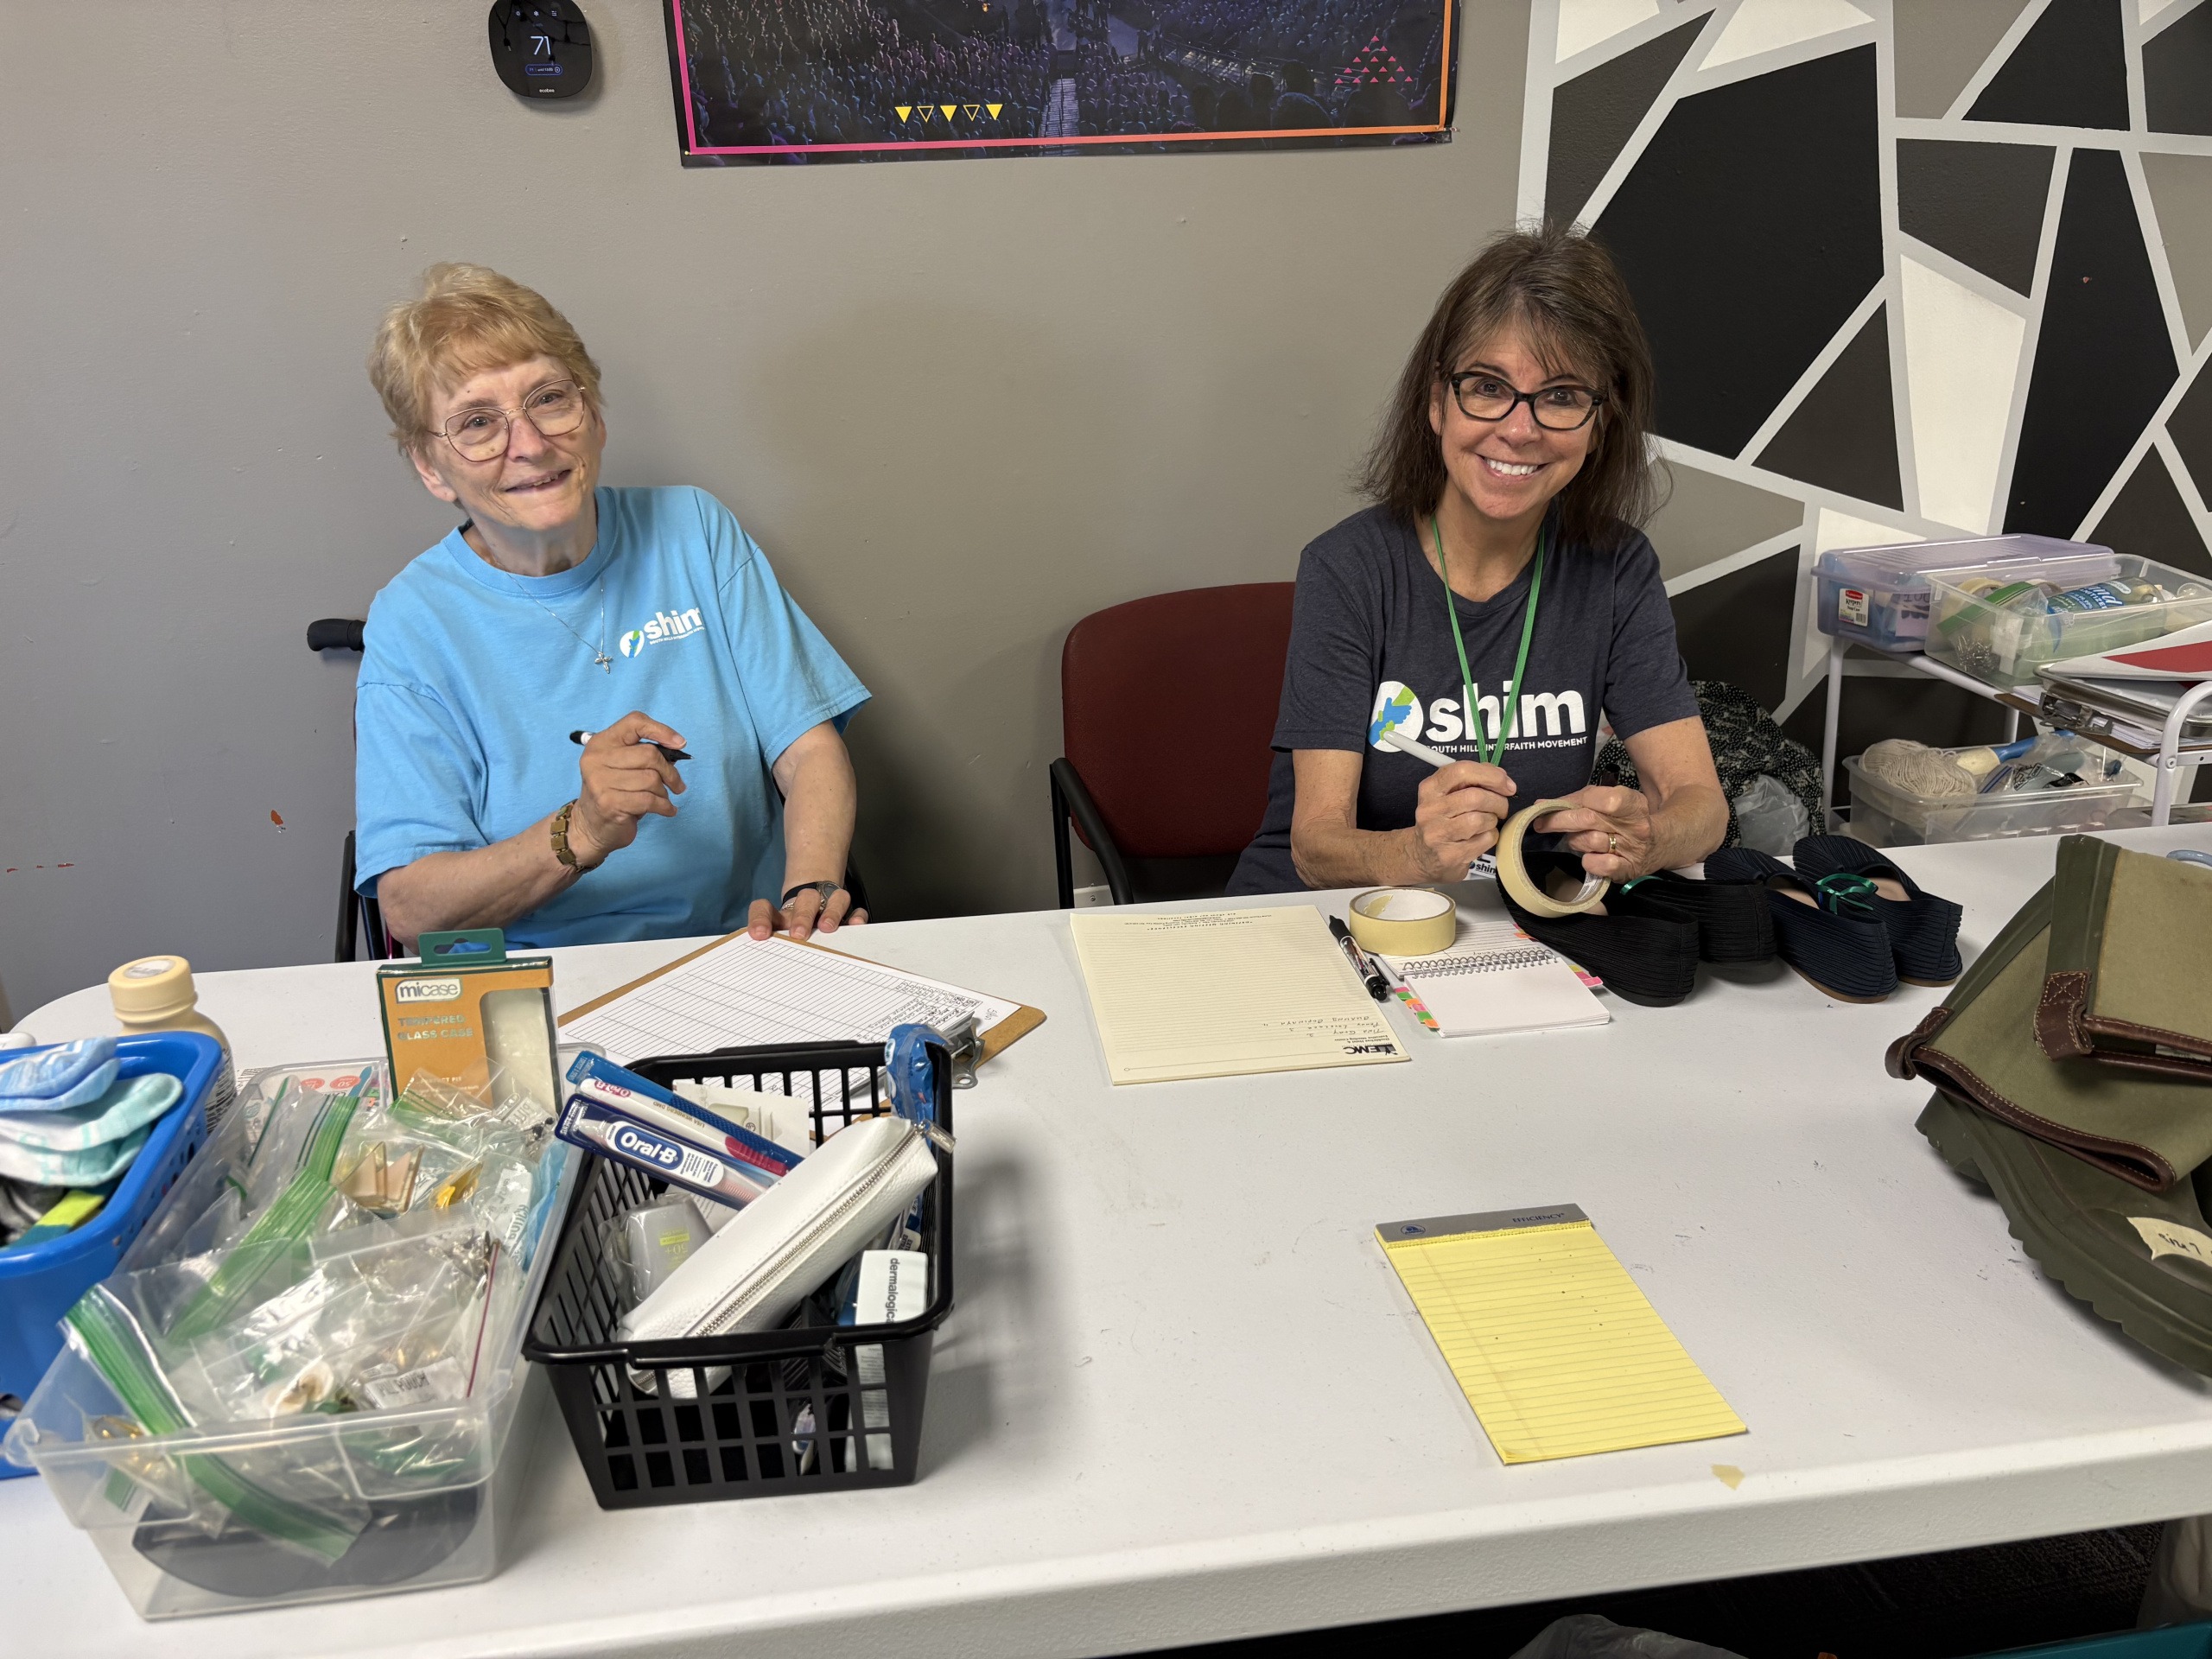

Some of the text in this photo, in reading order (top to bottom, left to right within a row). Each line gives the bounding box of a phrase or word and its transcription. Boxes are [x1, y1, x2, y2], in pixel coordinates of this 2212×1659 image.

[531, 35, 551, 55] 71
[1426, 680, 1586, 742] shim
[1537, 736, 1588, 749] MOVEMENT
[400, 982, 458, 998] micase
[397, 1014, 466, 1027] TEMPERED
[397, 1027, 474, 1041] GLASS CASE
[665, 1105, 694, 1122] WEINBERG
[692, 1119, 706, 1128] LISA
[620, 1131, 678, 1165] Oral-B
[885, 1257, 900, 1324] dermalogica
